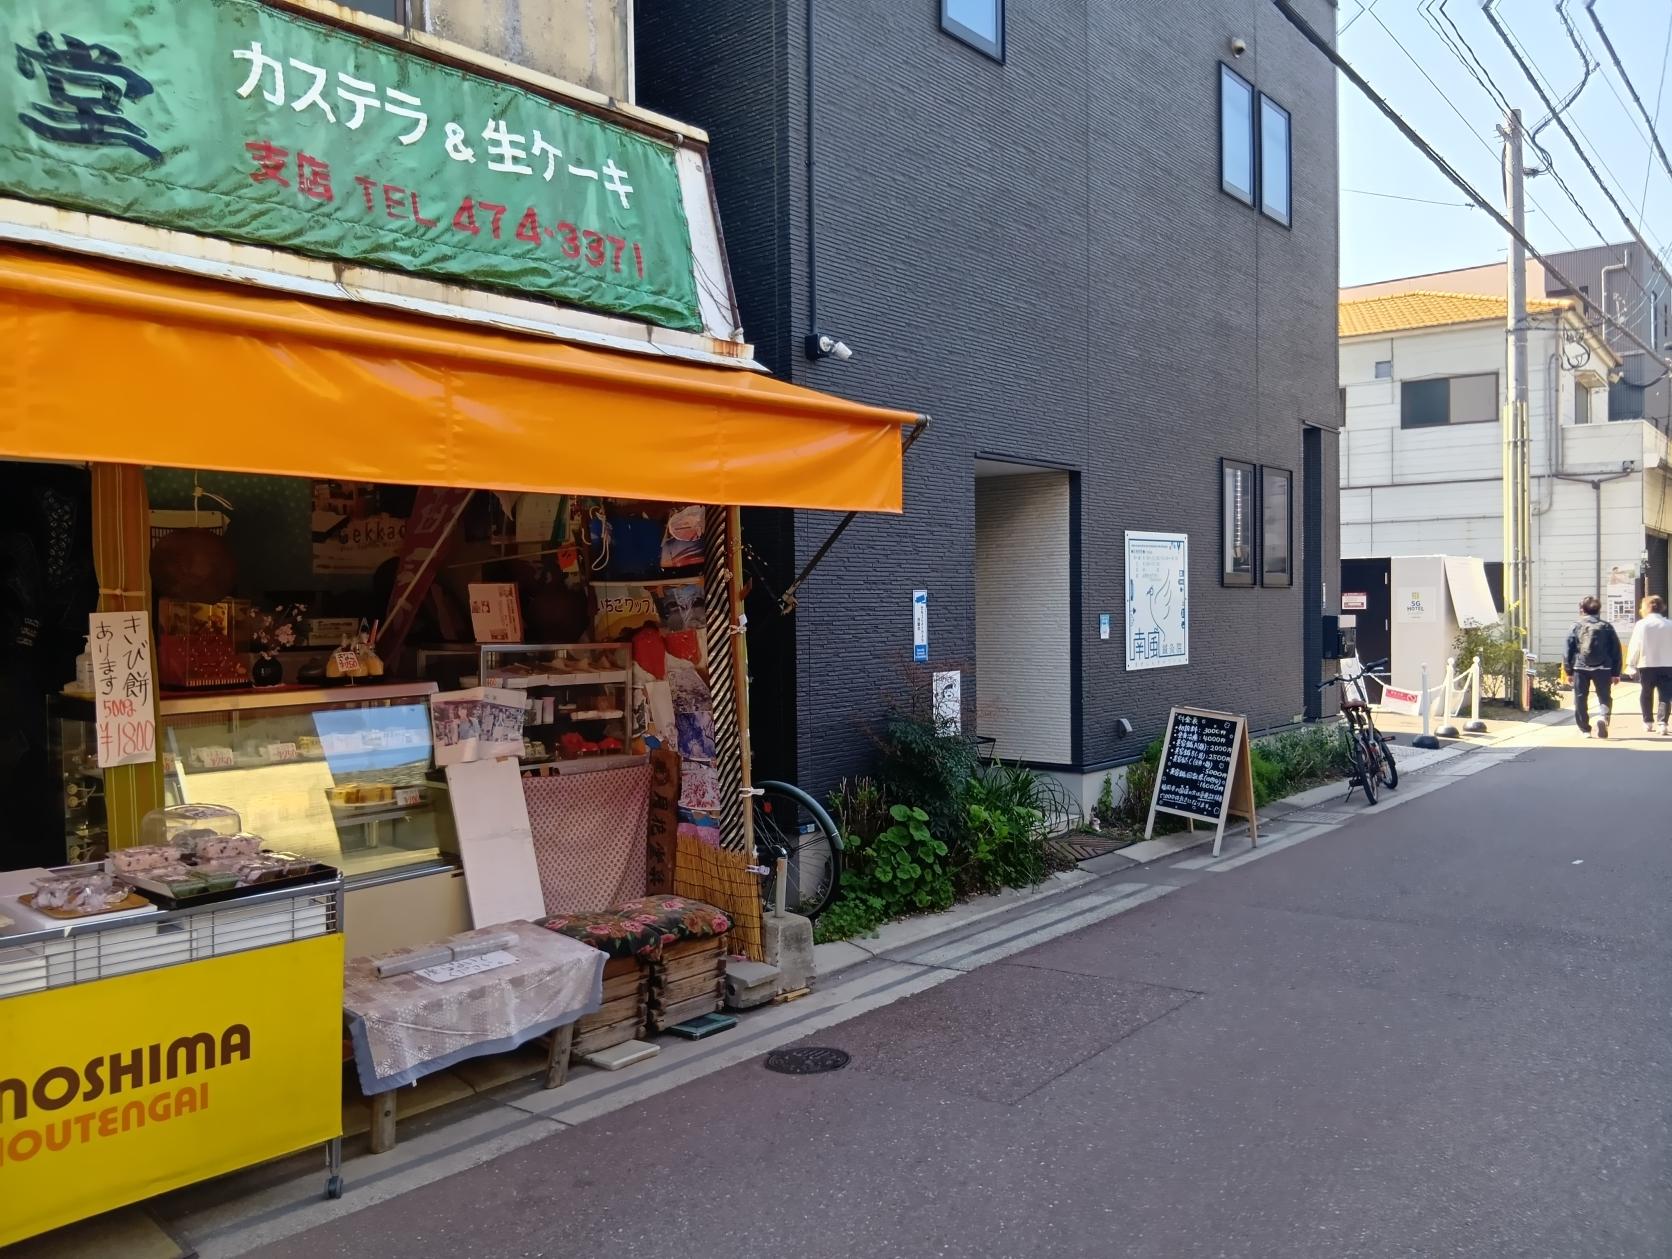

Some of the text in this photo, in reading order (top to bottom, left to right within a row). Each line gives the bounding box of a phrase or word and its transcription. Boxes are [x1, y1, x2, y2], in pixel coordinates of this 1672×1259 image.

[233, 40, 634, 210] カステラ & 生ケーキ
[245, 139, 334, 202] 支店
[354, 175, 438, 229] TEL
[96, 620, 118, 696] あります
[123, 615, 150, 707] きび餅
[100, 719, 155, 764] ¥1800
[103, 698, 136, 719] 500g
